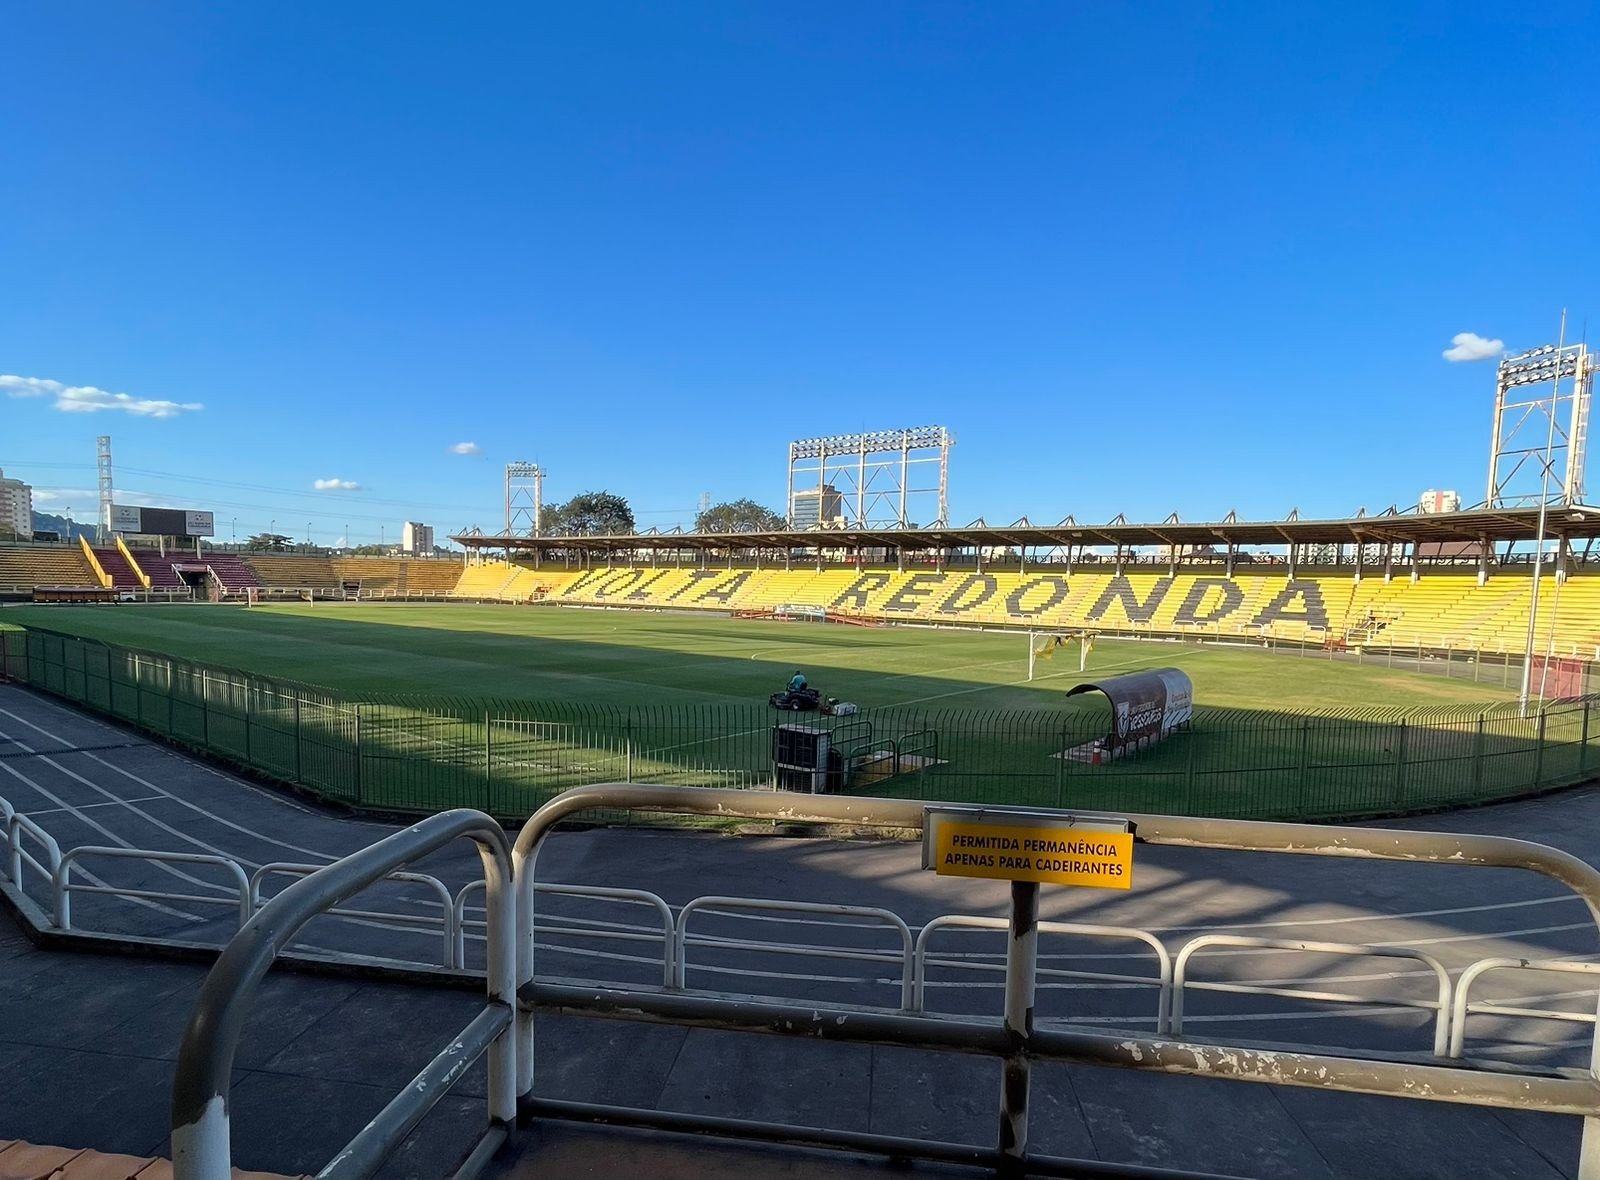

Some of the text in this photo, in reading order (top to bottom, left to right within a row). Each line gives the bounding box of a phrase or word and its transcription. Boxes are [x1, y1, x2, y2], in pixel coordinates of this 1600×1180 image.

[561, 568, 1329, 632] VOLTA REDONDA
[952, 835, 1117, 857] PERMITIDA PERMANÊNCIA
[944, 852, 1123, 876] APENAS PARA CADEIRANTES
